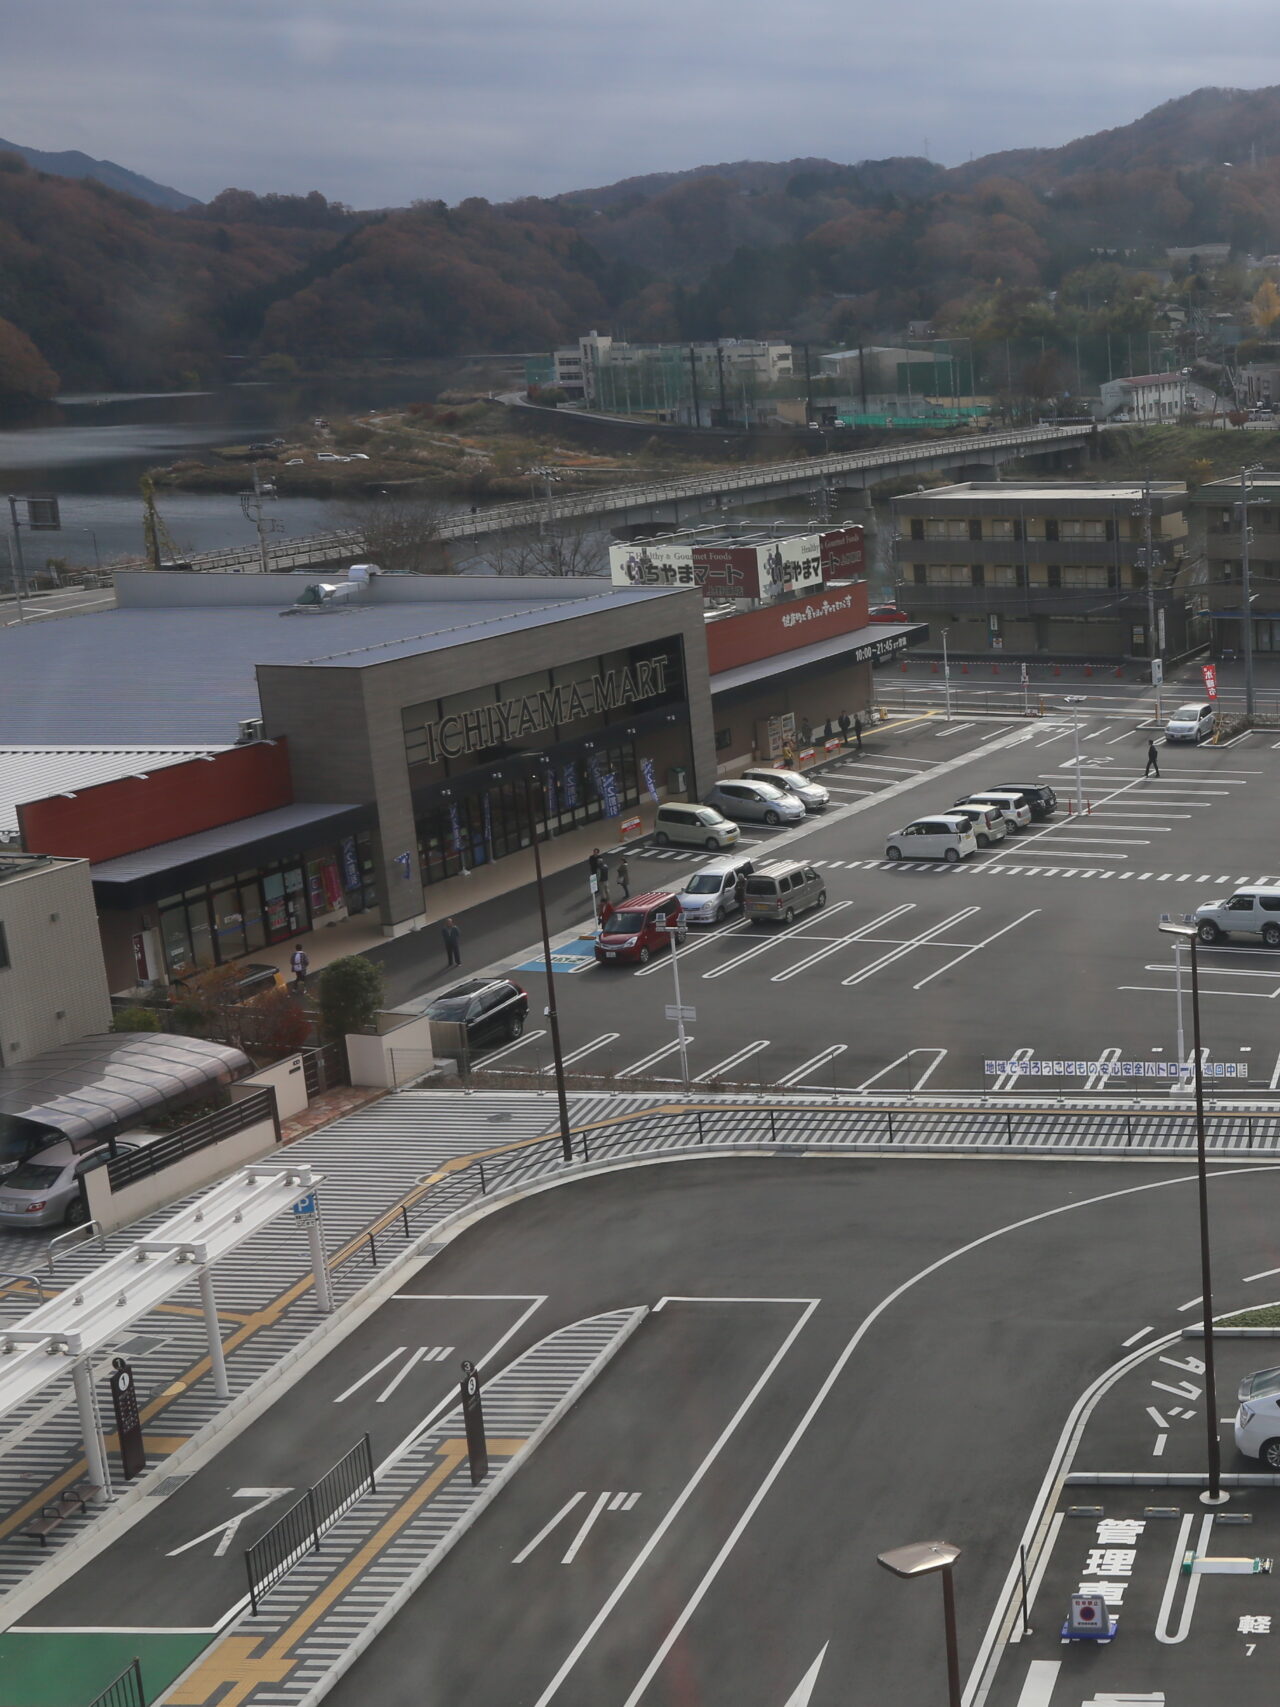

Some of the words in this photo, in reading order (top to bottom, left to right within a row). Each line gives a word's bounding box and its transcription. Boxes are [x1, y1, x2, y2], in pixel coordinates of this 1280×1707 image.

[673, 552, 707, 561] Gourmet
[709, 552, 732, 561] Foods
[626, 563, 744, 585] いちやまマート
[772, 552, 841, 585] いちやまマート
[424, 681, 589, 765] ICHIYAMA
[591, 654, 668, 714] MART
[297, 1196, 309, 1212] P
[464, 1361, 471, 1371] 3
[469, 1379, 475, 1391] 3
[1146, 1355, 1206, 1456] タクシー
[1061, 1518, 1147, 1644] 管理車
[1237, 1615, 1273, 1634] 軽
[1245, 1643, 1257, 1657] 7
